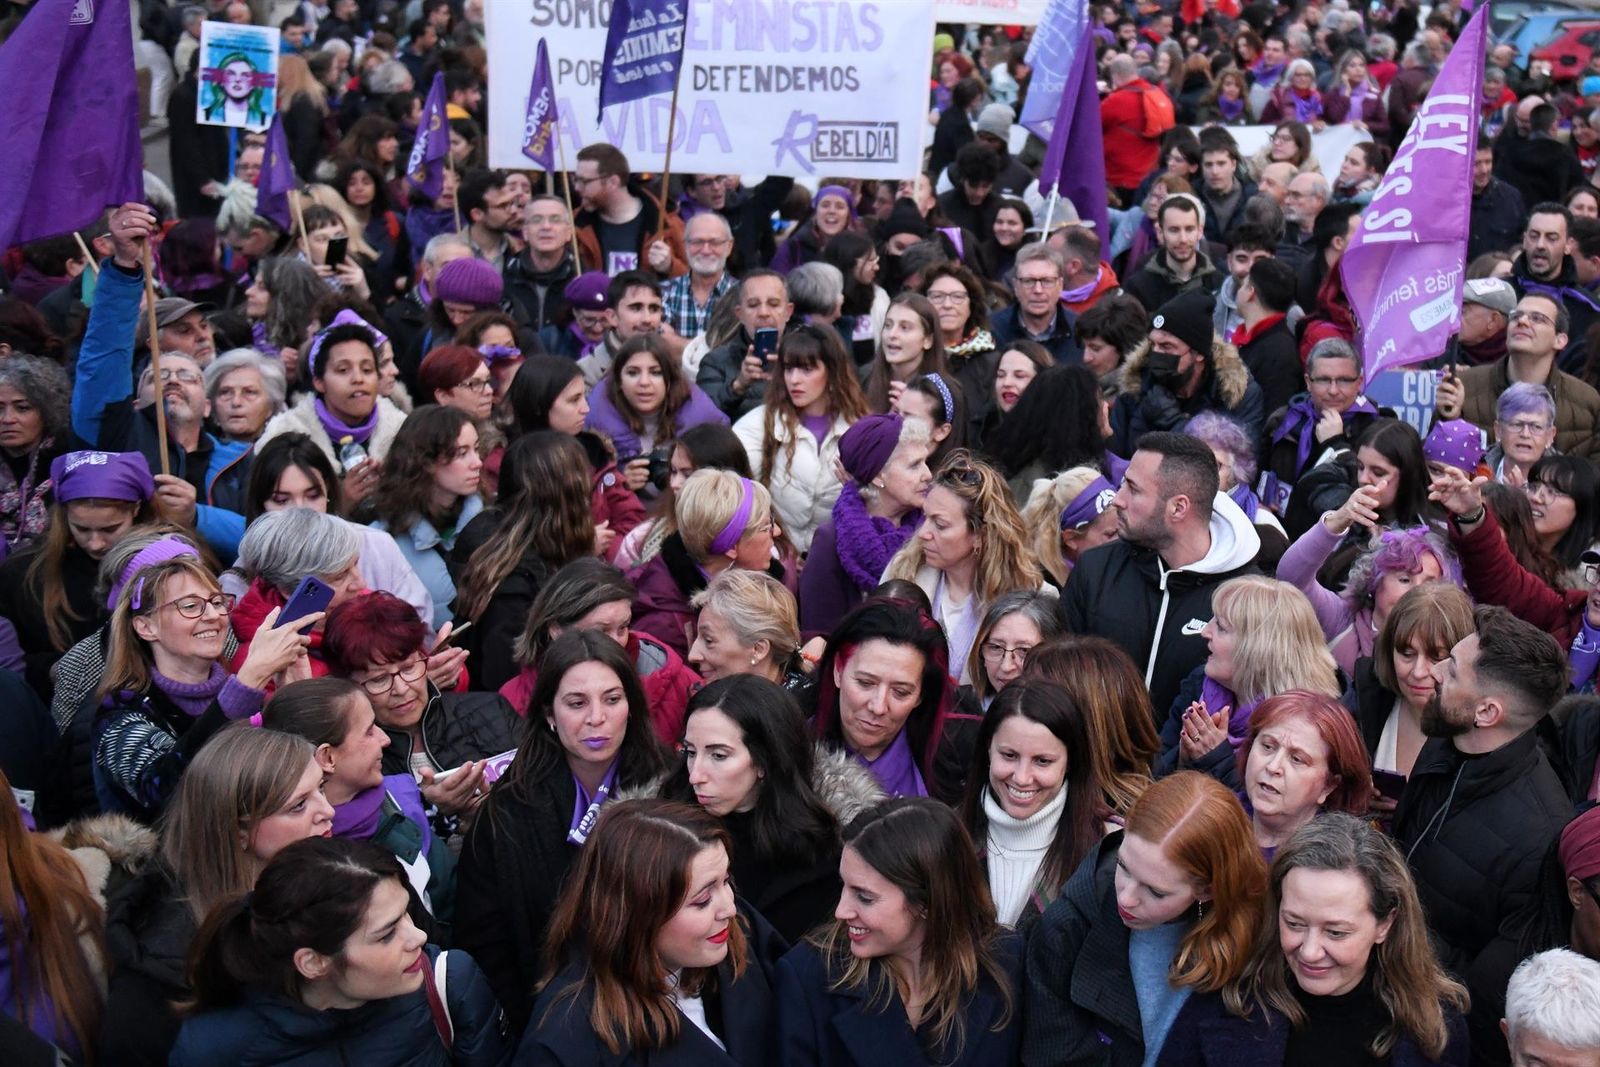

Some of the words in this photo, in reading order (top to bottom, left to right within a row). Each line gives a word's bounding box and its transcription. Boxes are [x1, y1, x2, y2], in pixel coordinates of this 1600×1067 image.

[693, 64, 861, 93] DEFENDEMOS
[595, 97, 734, 155] VIDA
[1416, 94, 1470, 156] LEY
[1362, 207, 1420, 245] SÍ
